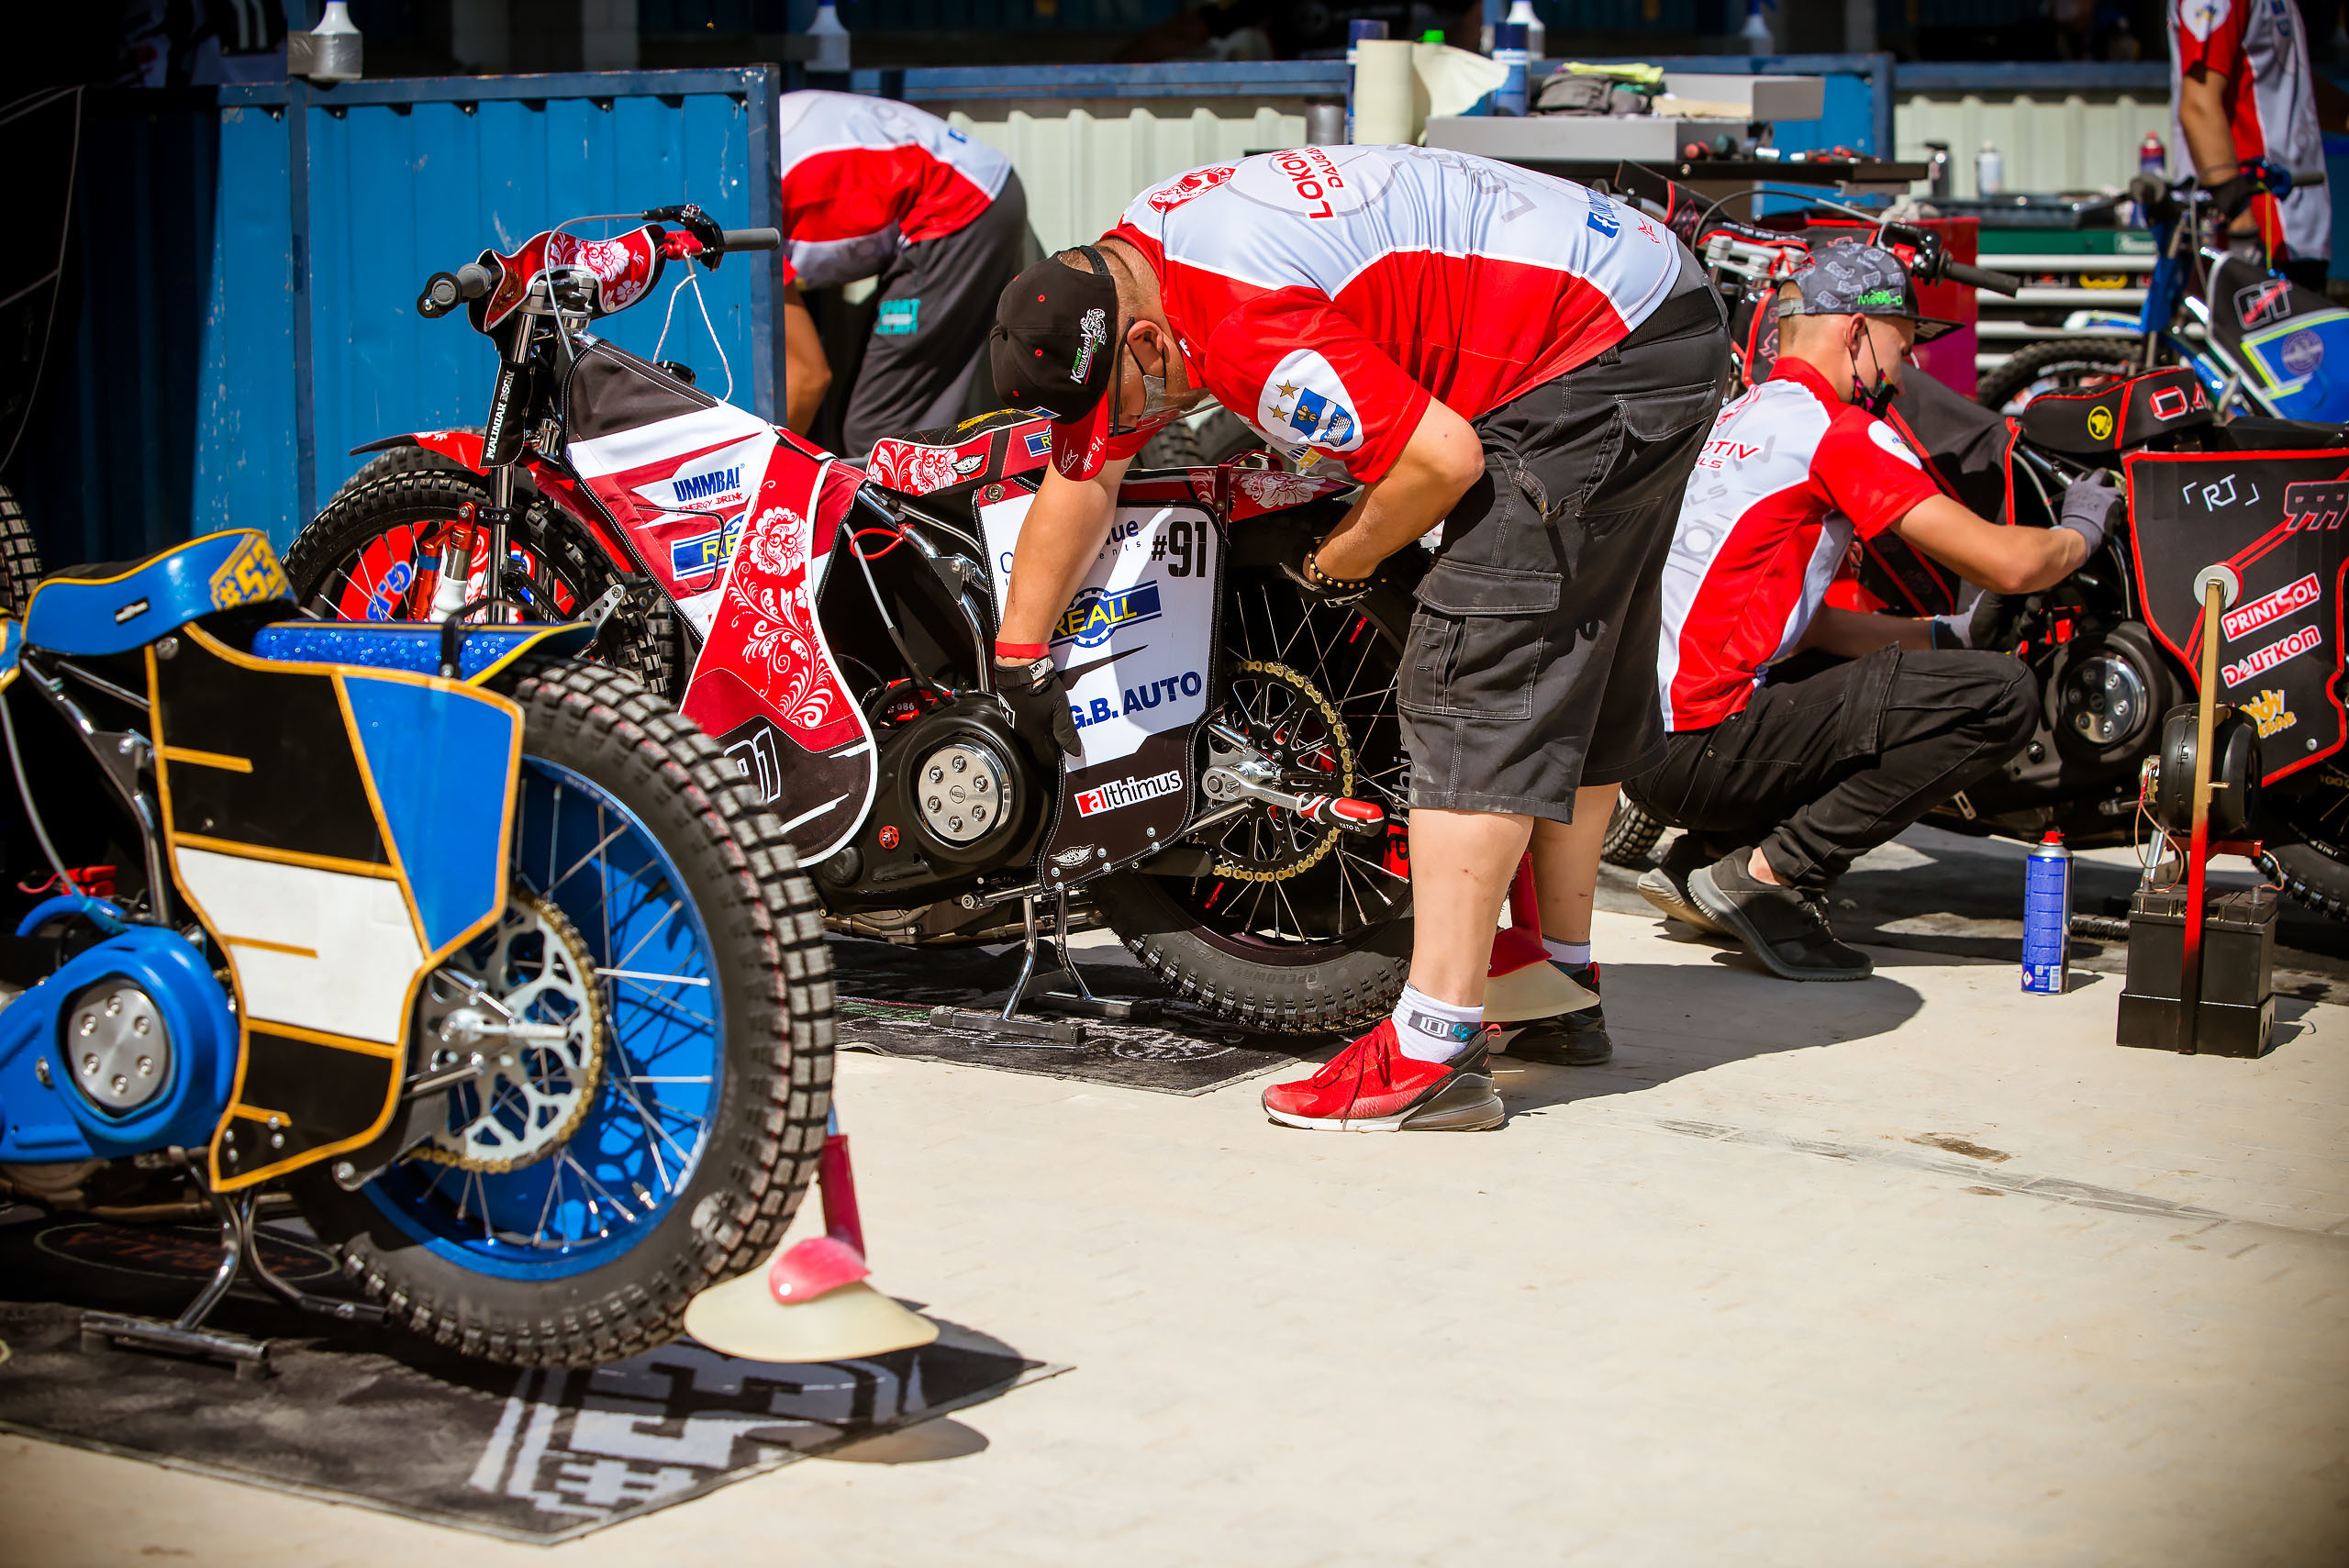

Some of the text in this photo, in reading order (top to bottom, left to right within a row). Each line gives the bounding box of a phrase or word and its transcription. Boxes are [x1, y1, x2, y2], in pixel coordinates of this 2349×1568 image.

[715, 492, 743, 505] DRINK
[1151, 520, 1208, 578] #91
[2228, 582, 2318, 635] PRINTSOL
[1123, 671, 1202, 717] AUTO
[1085, 772, 1182, 814] althimus
[1339, 822, 1354, 831] YATO
